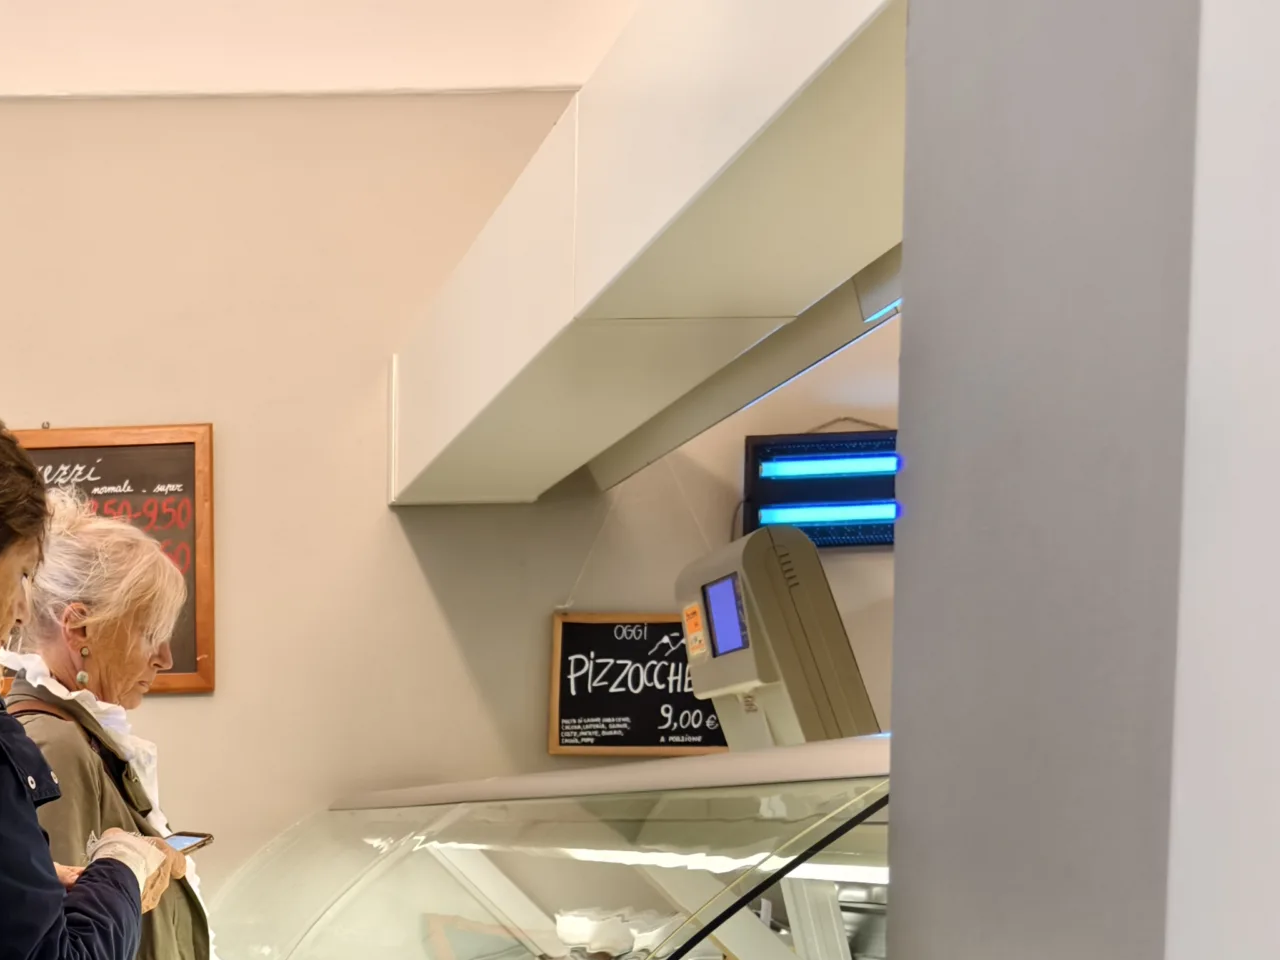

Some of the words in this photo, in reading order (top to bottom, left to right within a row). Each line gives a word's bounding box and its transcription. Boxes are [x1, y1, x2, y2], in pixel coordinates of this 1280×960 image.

[91, 479, 133, 495] normale
[153, 482, 184, 495] super
[657, 703, 703, 731] 9,00
[705, 714, 719, 730] €
